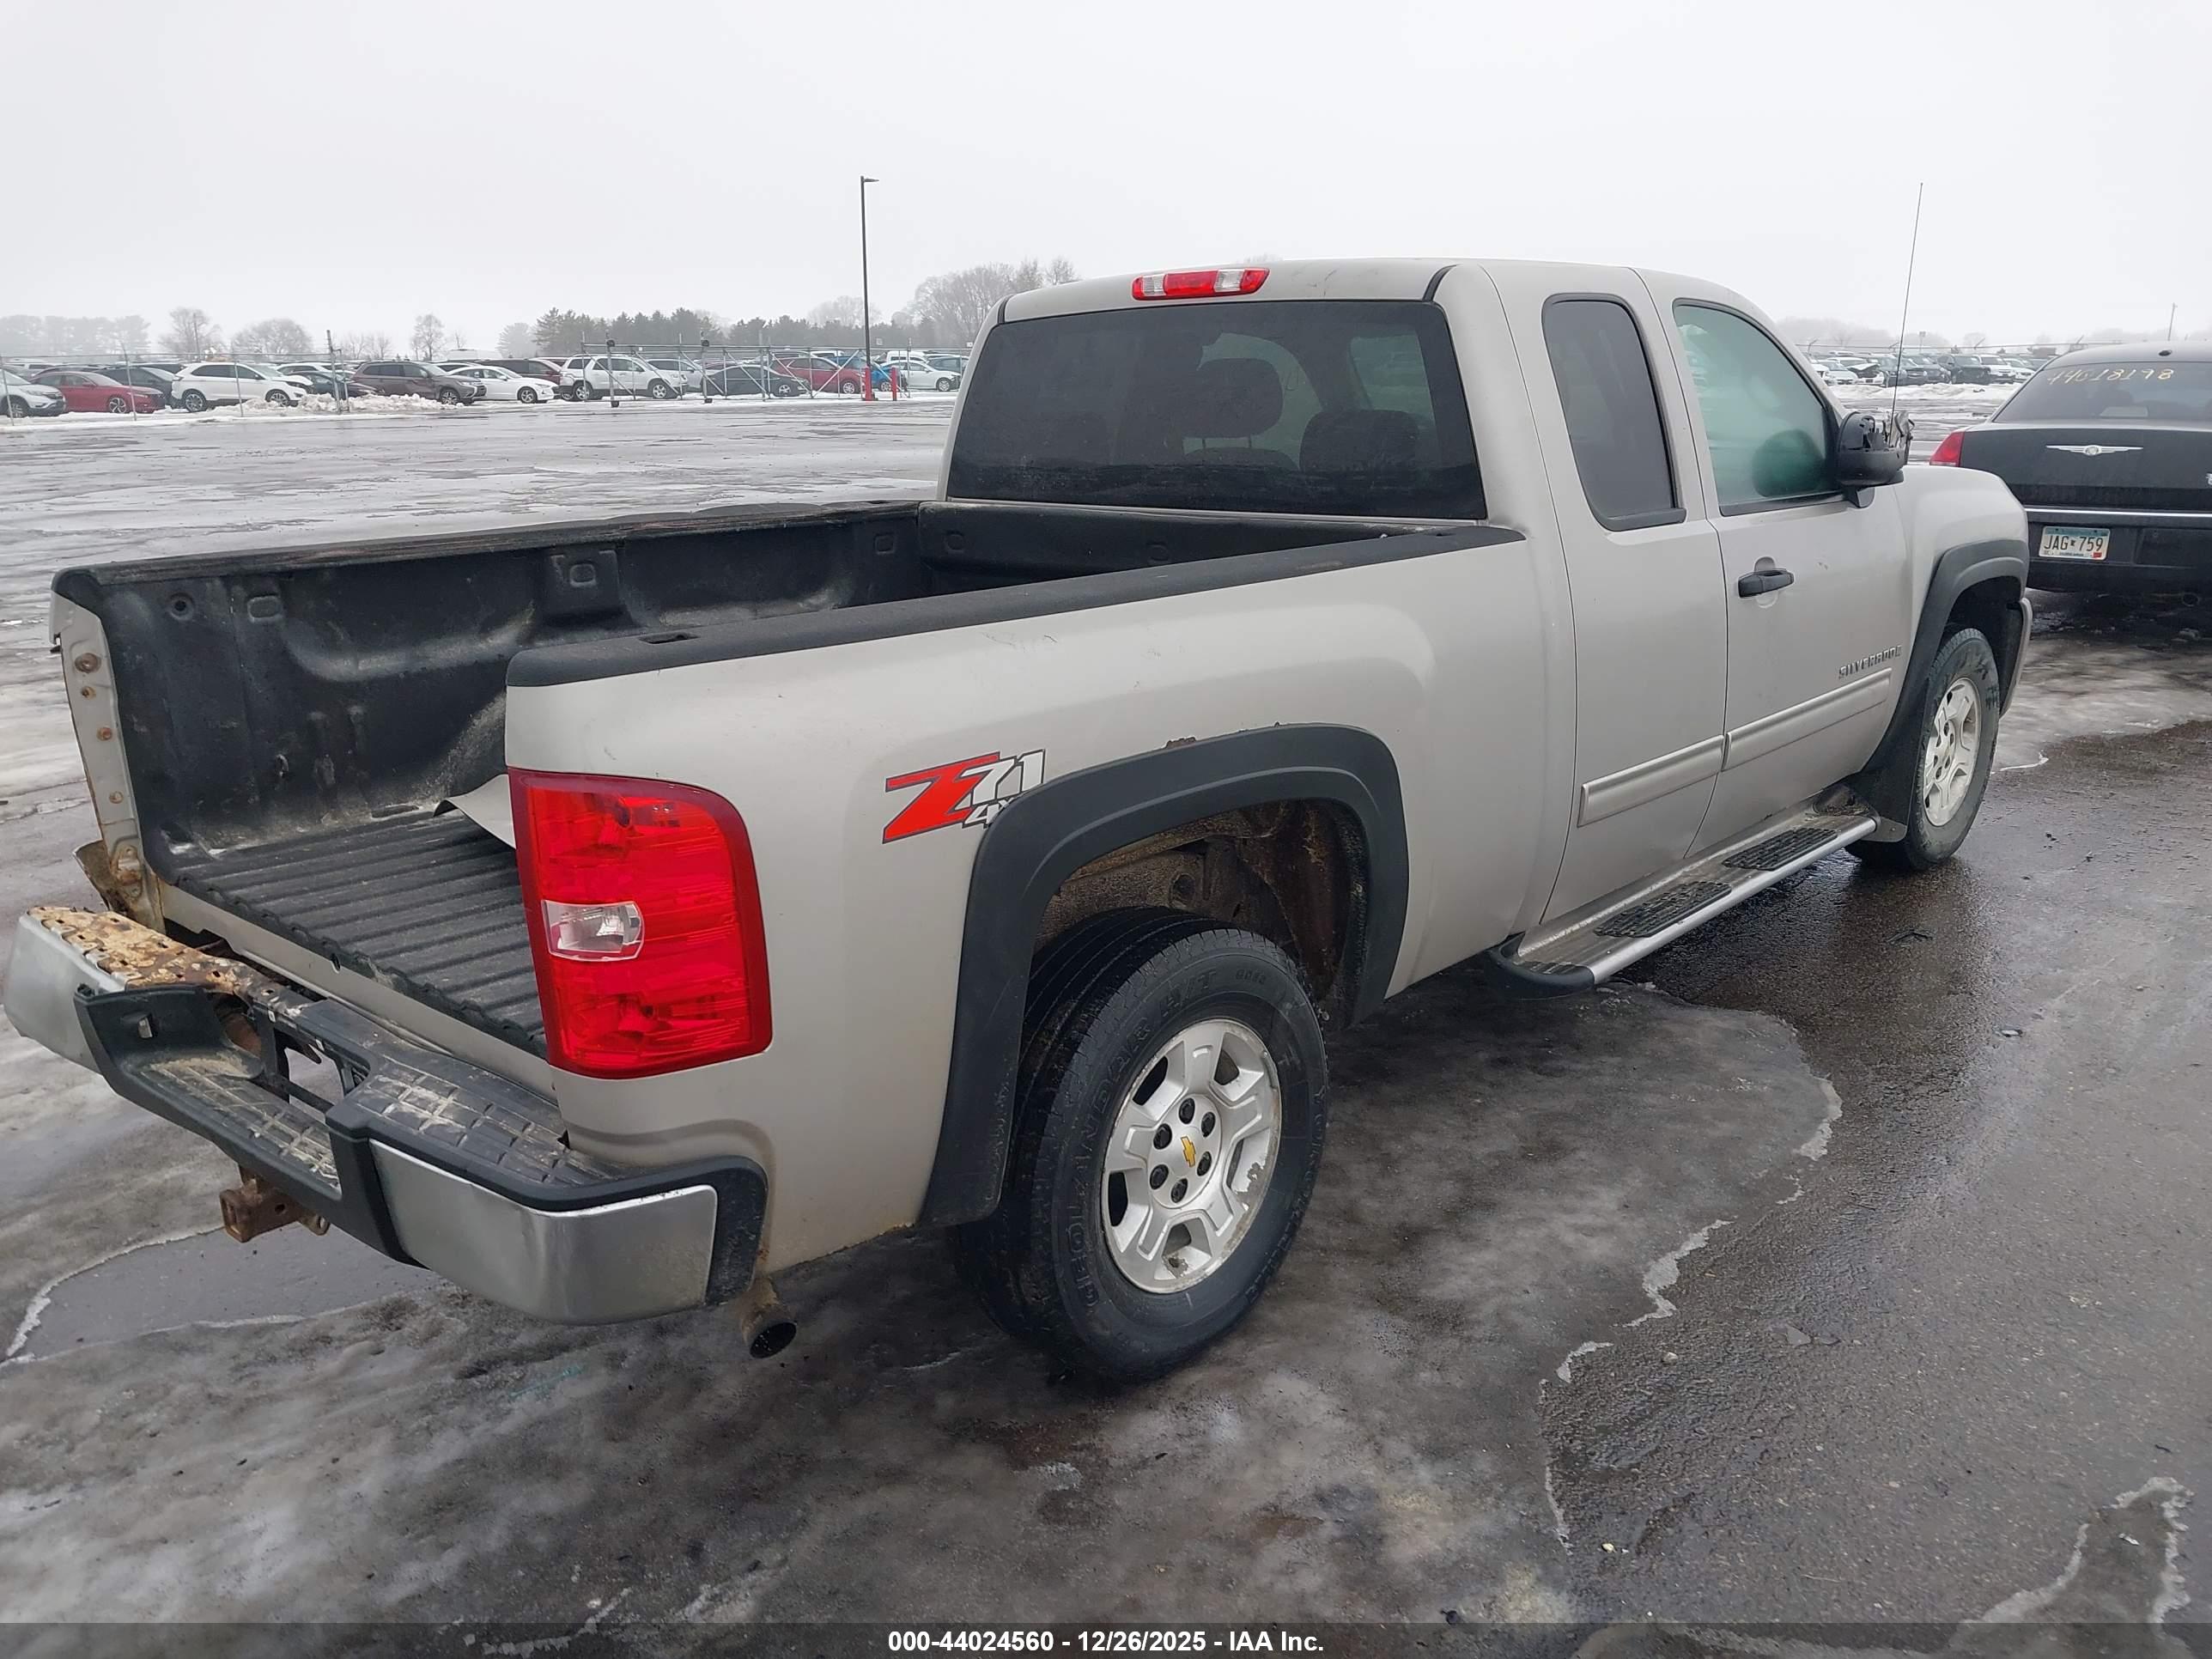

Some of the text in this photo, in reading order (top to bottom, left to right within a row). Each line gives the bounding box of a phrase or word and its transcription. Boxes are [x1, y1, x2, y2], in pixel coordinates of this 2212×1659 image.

[2044, 534, 2104, 552] JAG 759
[1839, 646, 1902, 678] SILVERADO
[882, 748, 1046, 845] Z71
[962, 797, 1015, 829] 4X
